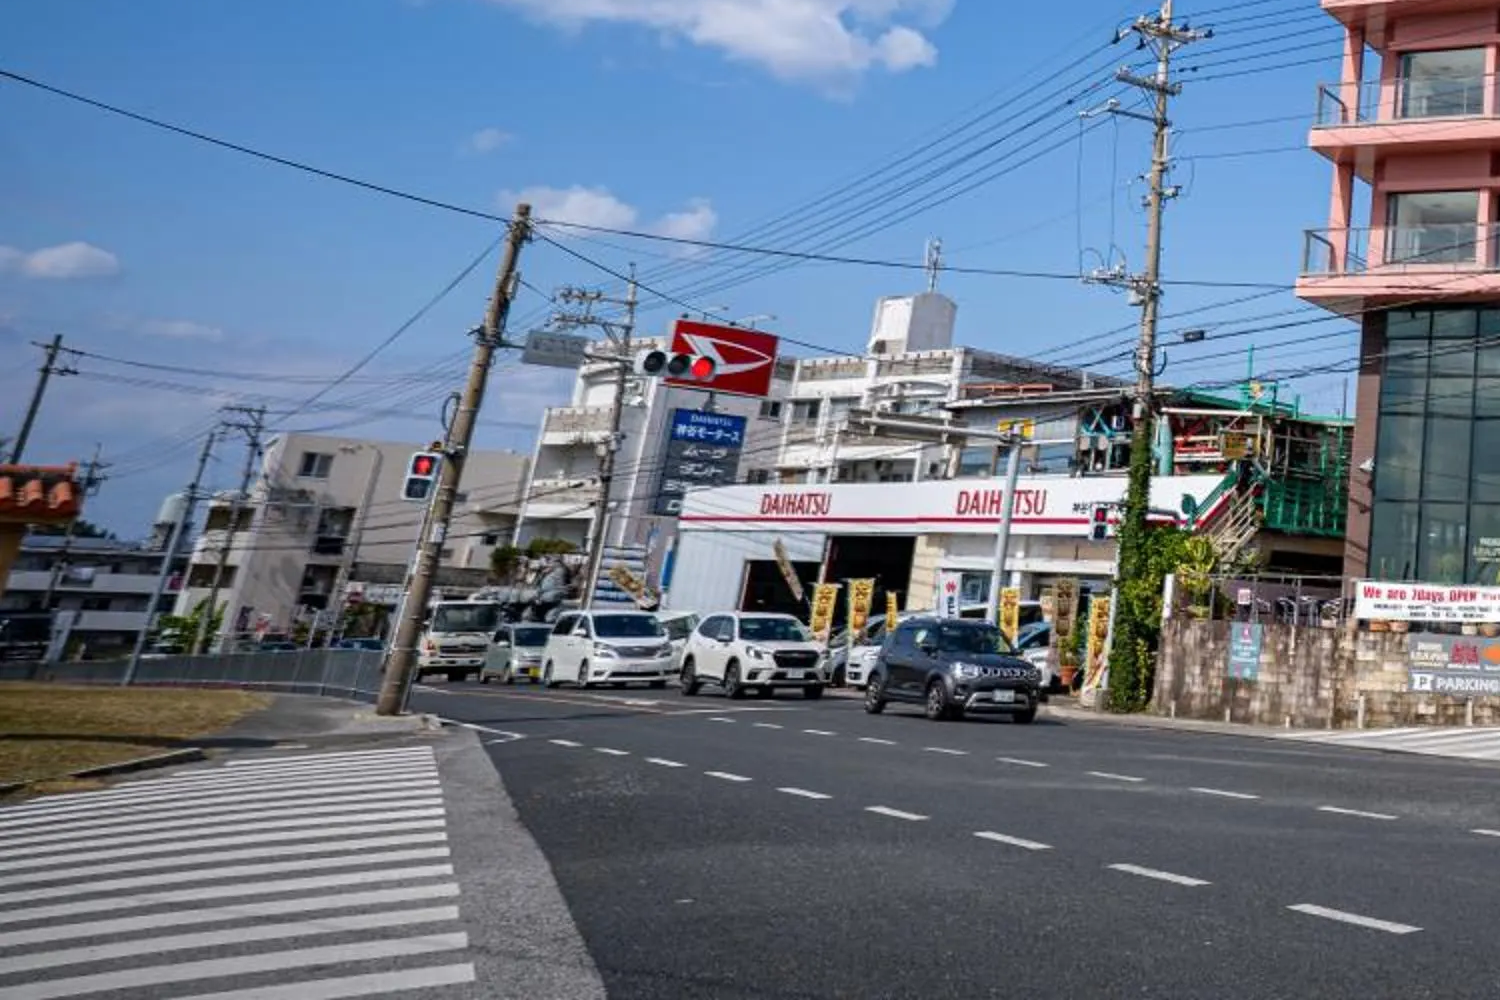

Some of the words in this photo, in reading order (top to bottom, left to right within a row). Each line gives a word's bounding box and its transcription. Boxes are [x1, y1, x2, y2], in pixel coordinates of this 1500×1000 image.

[760, 493, 832, 515] DAIHATSU
[956, 489, 1047, 515] DAIHTSU
[1363, 585, 1382, 599] We
[1387, 588, 1407, 600] are
[1449, 588, 1477, 602] OPEN
[1435, 676, 1499, 693] PARKING
